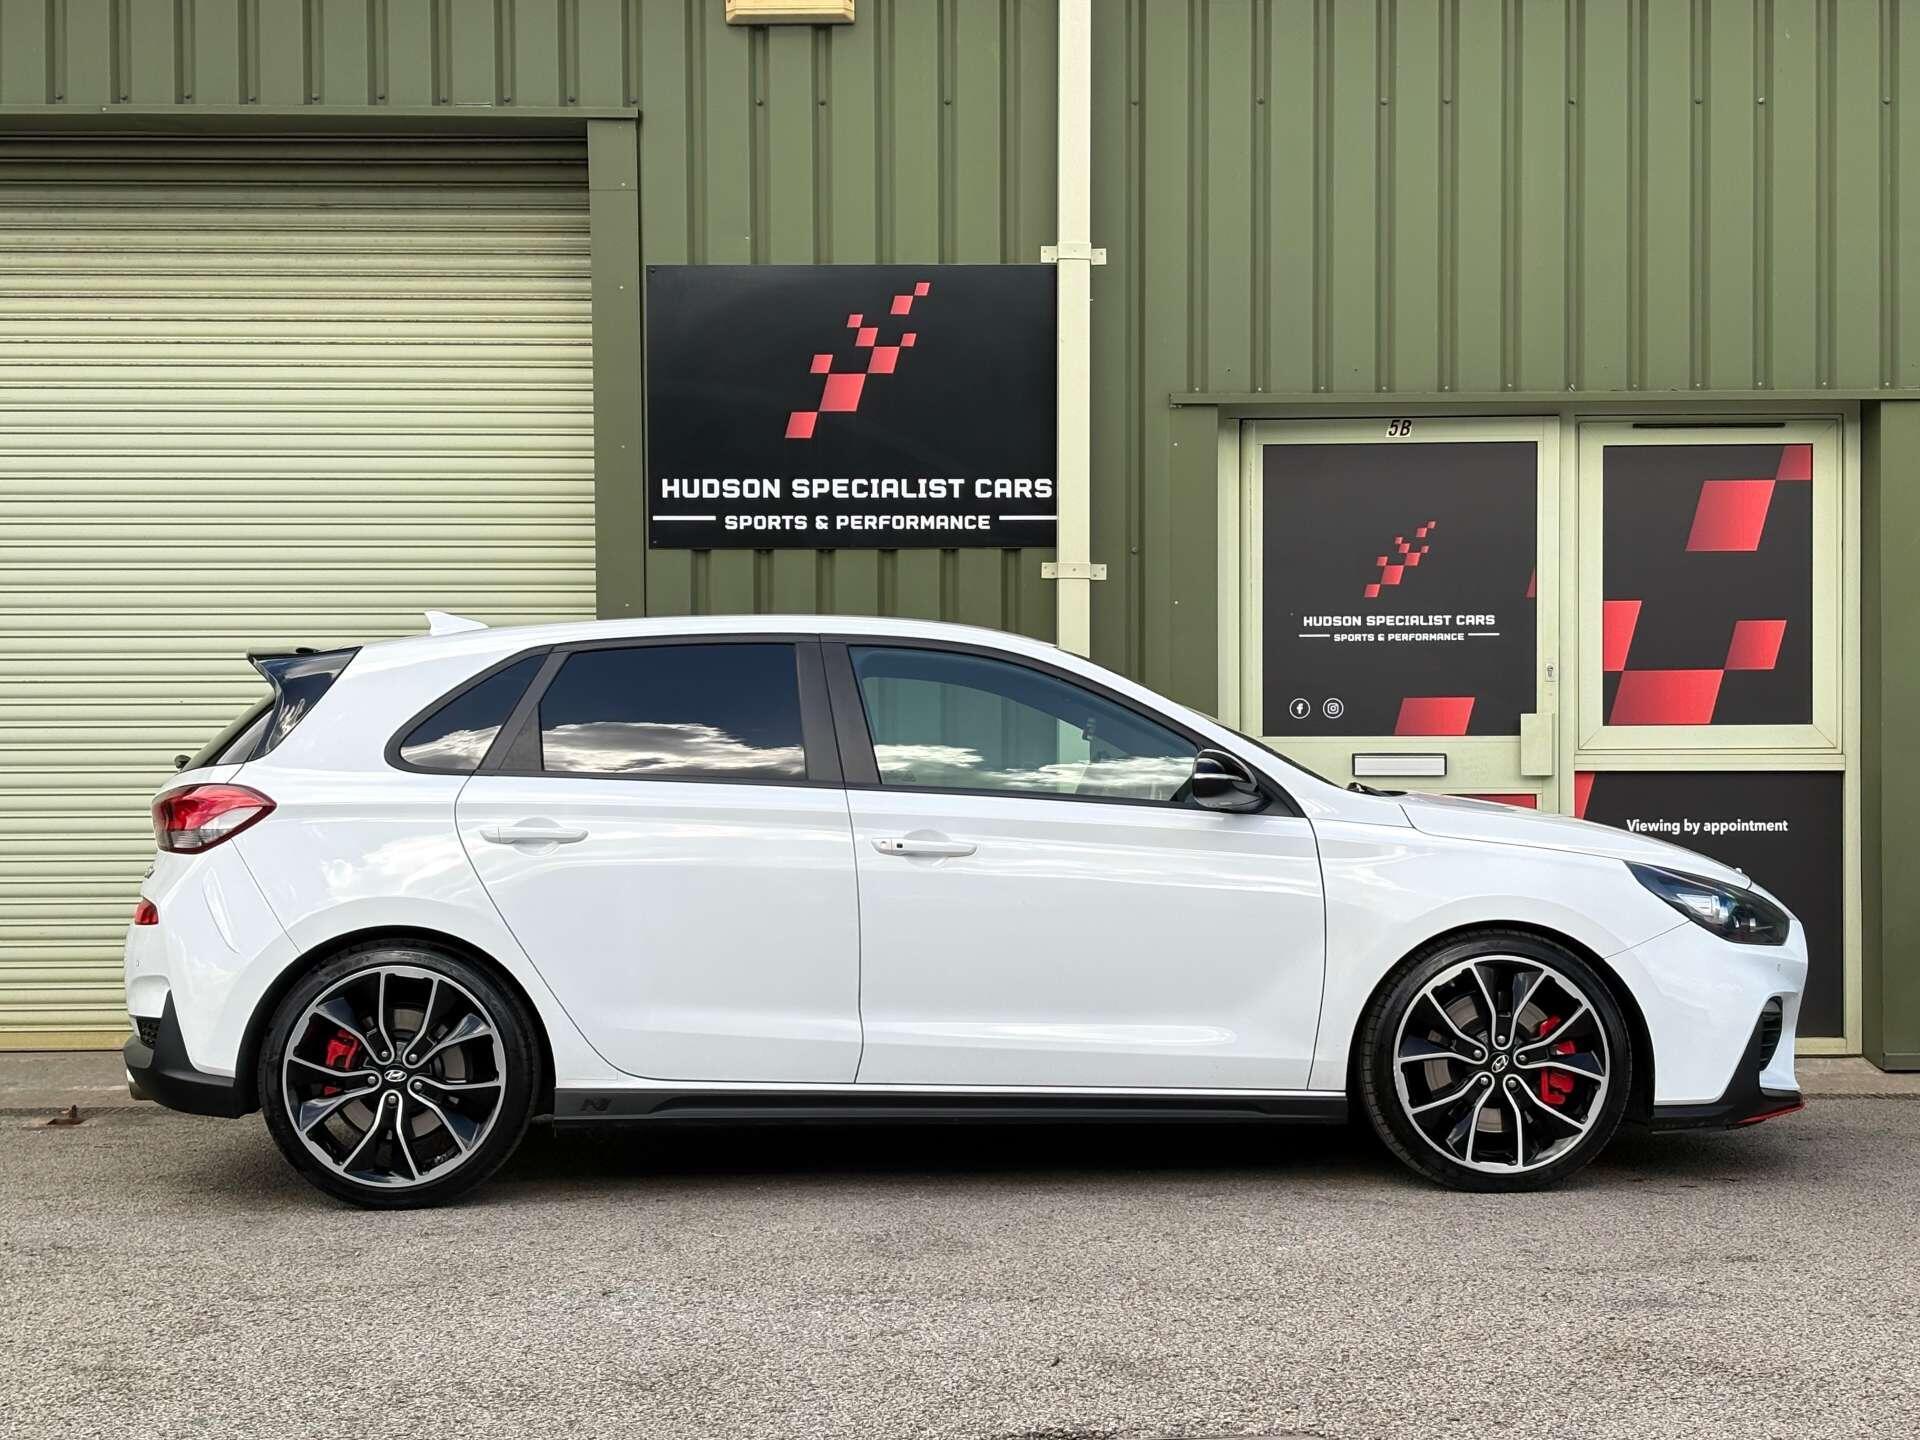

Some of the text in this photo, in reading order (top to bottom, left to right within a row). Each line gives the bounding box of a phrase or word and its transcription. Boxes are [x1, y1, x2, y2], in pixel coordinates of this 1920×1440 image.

[1388, 419, 1412, 436] 5B
[661, 478, 1053, 499] HUDSON SPECIALIST CARS
[724, 514, 991, 530] SPORTS & PERFORMANCE
[1303, 614, 1496, 627] HUDSON SPECIALIST CARS
[1333, 632, 1465, 642] SPORTS & PERFORMANCE
[1626, 818, 1789, 835] Viewing by appointment
